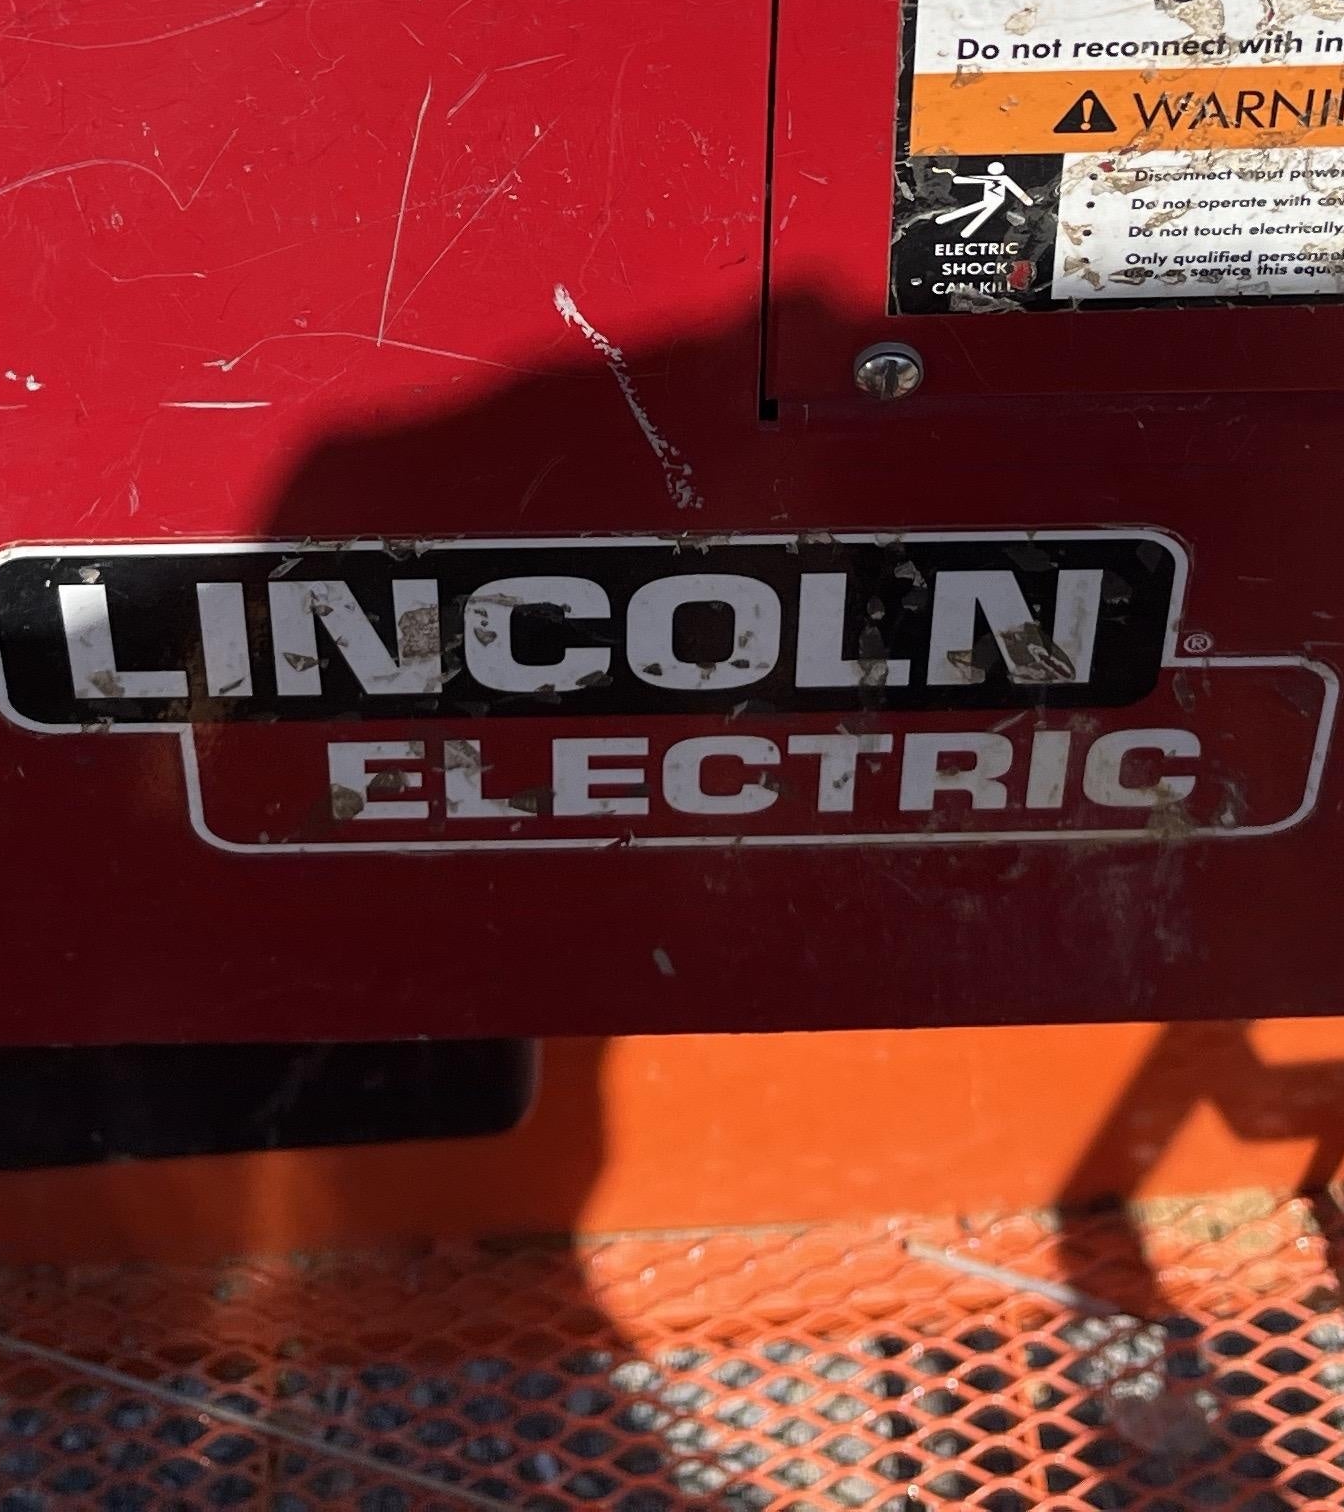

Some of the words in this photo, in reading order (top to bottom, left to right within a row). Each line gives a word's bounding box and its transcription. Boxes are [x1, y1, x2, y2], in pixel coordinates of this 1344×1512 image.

[956, 37, 1000, 60] Do
[1011, 37, 1064, 60] not
[1073, 36, 1227, 59] reconnect
[1236, 30, 1303, 56] with
[1134, 168, 1234, 183] Disconnect
[1131, 198, 1160, 211] Do
[1162, 197, 1193, 211] not
[1198, 195, 1268, 213] operate
[1273, 193, 1312, 208] with
[1127, 225, 1154, 239] Do
[1159, 224, 1189, 238] not
[1193, 223, 1243, 238] touch
[934, 241, 1020, 257] ELECTRIC
[941, 261, 1008, 276] SHOCK
[1124, 252, 1168, 269] Only
[1171, 250, 1253, 268] qualified
[1188, 265, 1252, 280] service
[1256, 262, 1288, 277] this
[931, 281, 974, 295] CAN
[979, 280, 1017, 294] KILL
[57, 568, 1103, 702] LINCOLN
[326, 727, 1202, 822] ELECTRIC
